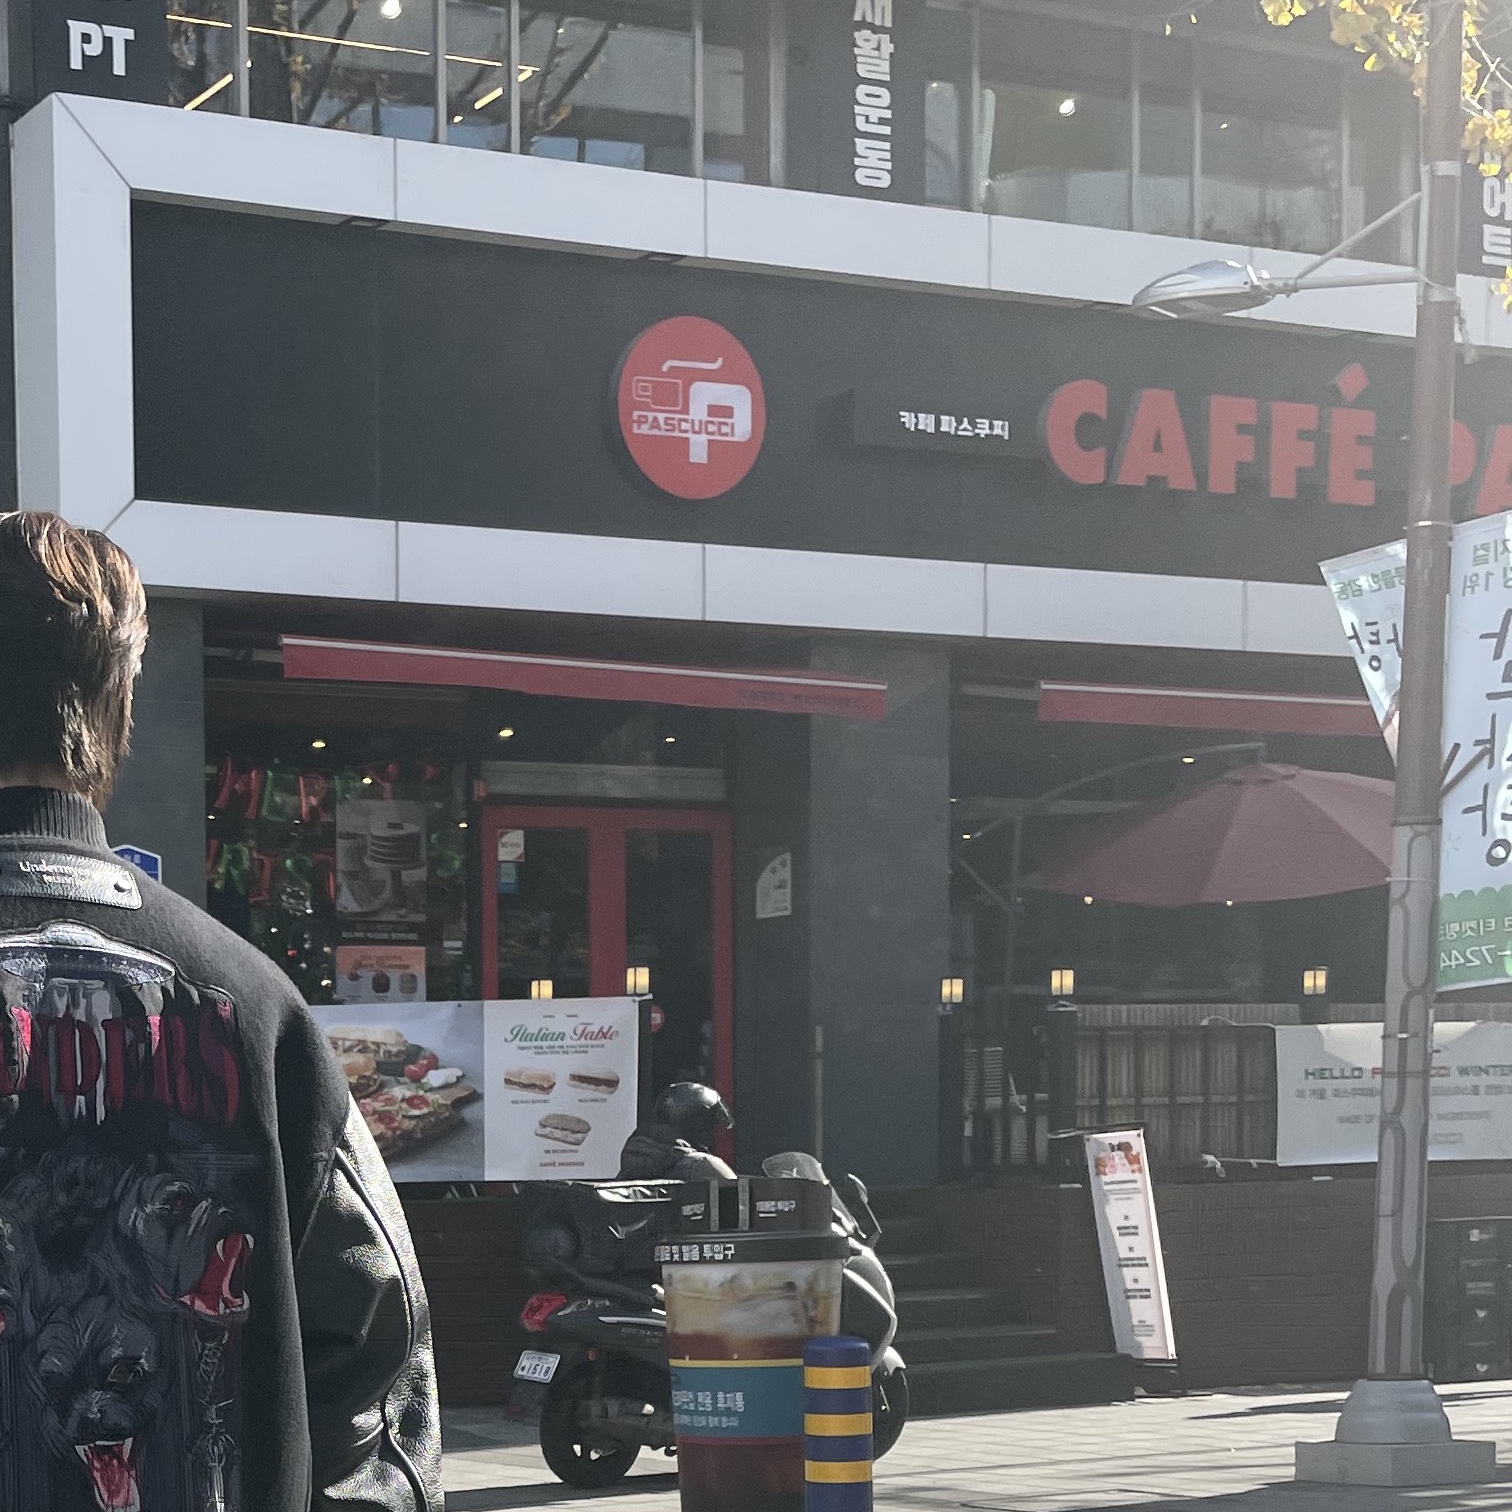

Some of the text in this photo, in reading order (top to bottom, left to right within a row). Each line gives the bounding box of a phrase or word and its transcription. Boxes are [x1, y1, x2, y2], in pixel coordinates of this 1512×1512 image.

[66, 19, 135, 77] PT
[636, 414, 735, 438] PASCUCCI
[898, 411, 936, 434] 카페
[504, 1022, 621, 1044] Italian Table
[1304, 1066, 1364, 1081] HELLO
